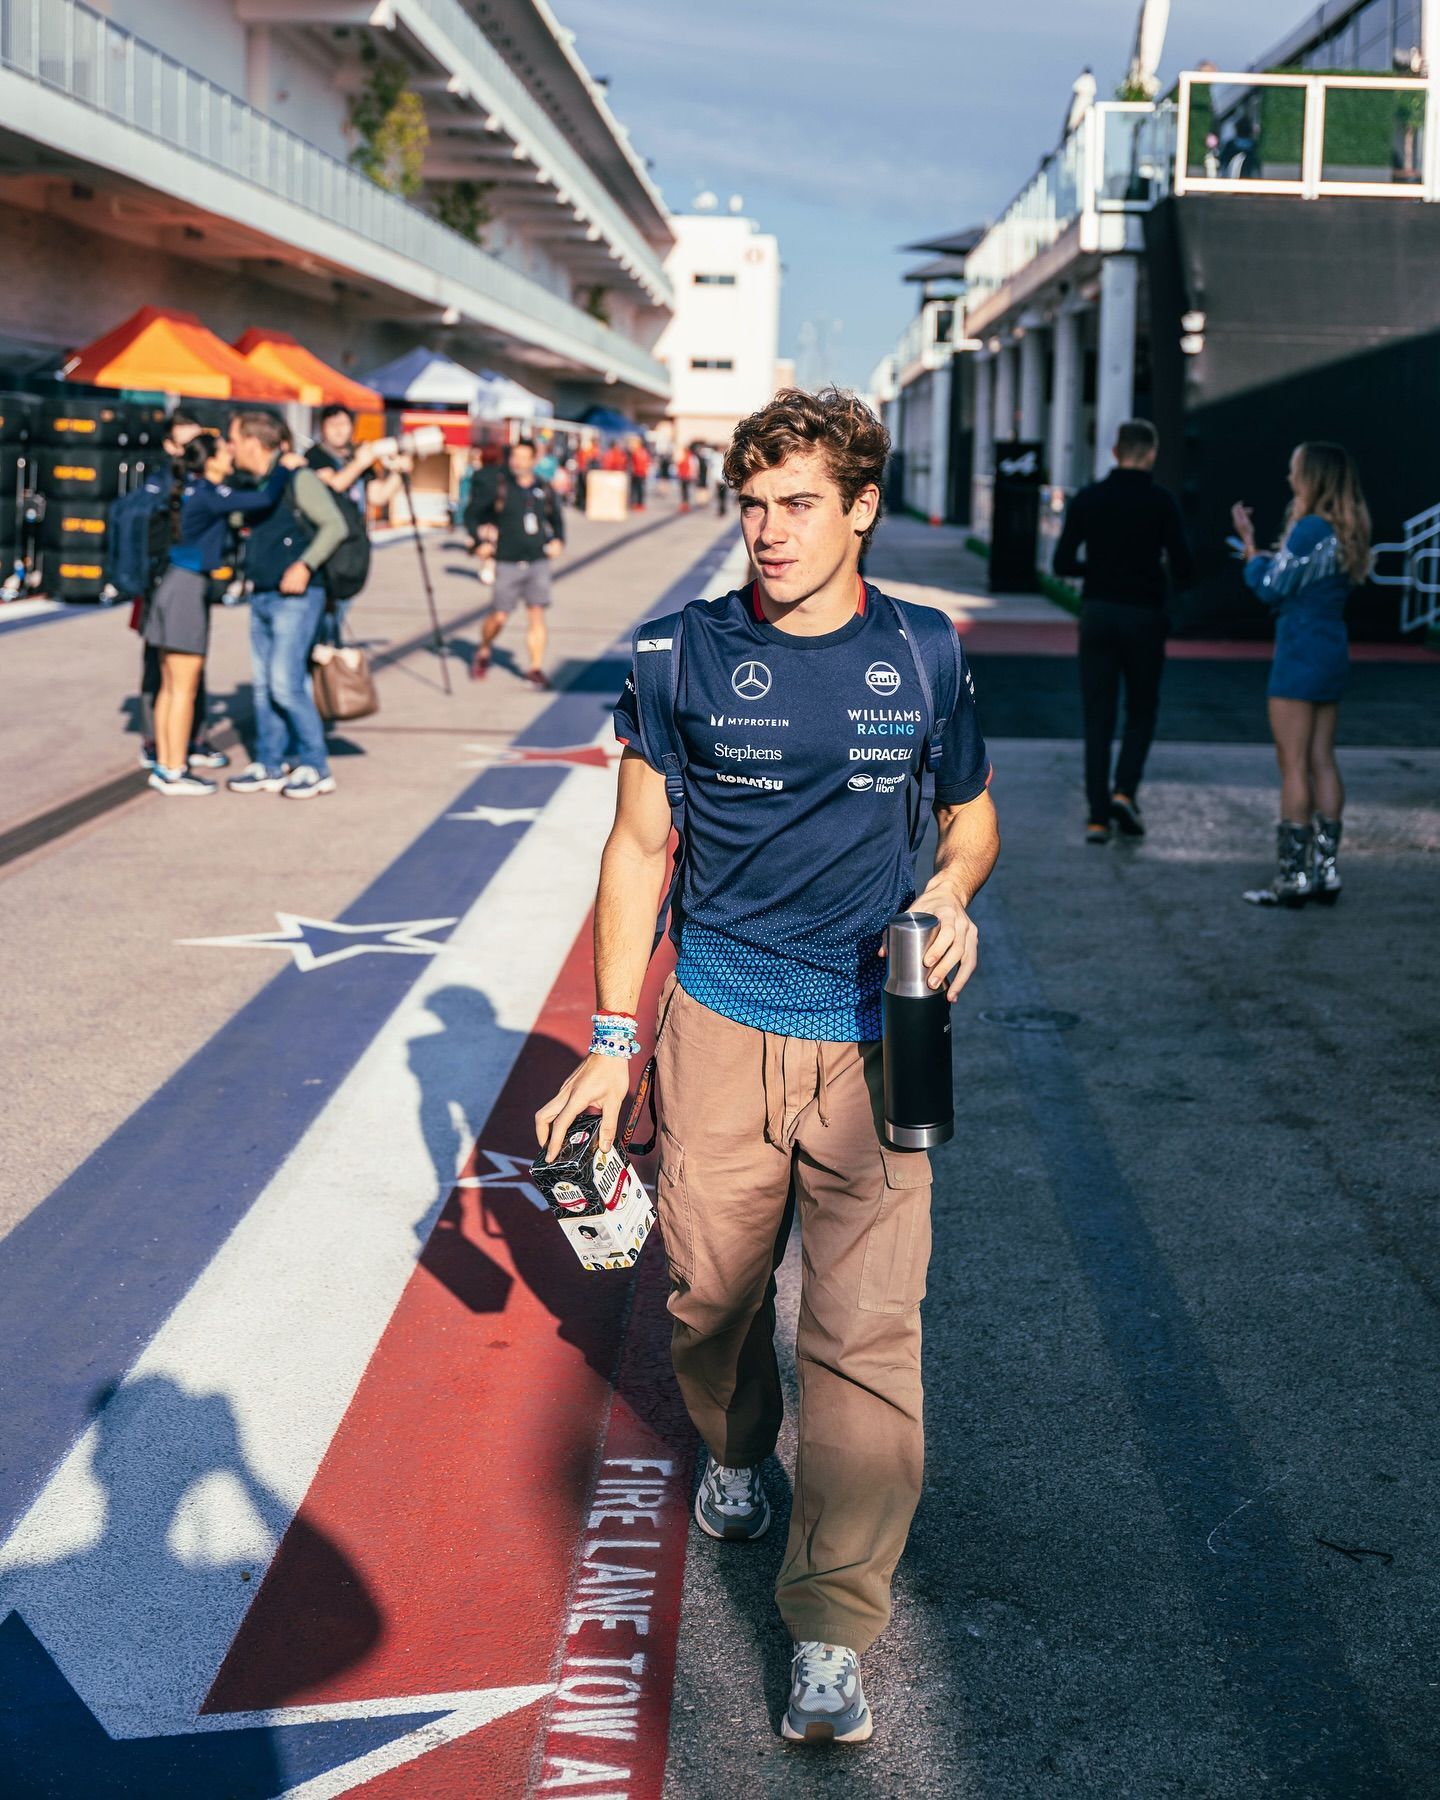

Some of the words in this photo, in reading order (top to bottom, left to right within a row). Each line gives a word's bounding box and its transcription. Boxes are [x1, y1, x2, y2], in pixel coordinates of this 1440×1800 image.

[868, 673, 898, 683] Gulf
[727, 717, 789, 727] MYPROTEIN
[847, 709, 921, 721] WILLIAMS
[857, 723, 915, 735] RACING
[714, 742, 782, 762] Stephens
[849, 748, 913, 760] DURACELL
[716, 772, 783, 791] KOMATSU
[875, 783, 895, 793] libre
[597, 1156, 622, 1198] NATURA
[556, 1189, 582, 1201] NATURA
[587, 1459, 673, 1529] FIRE
[567, 1540, 661, 1635] LANE
[550, 1652, 647, 1742] TOW
[541, 1756, 632, 1800] A
